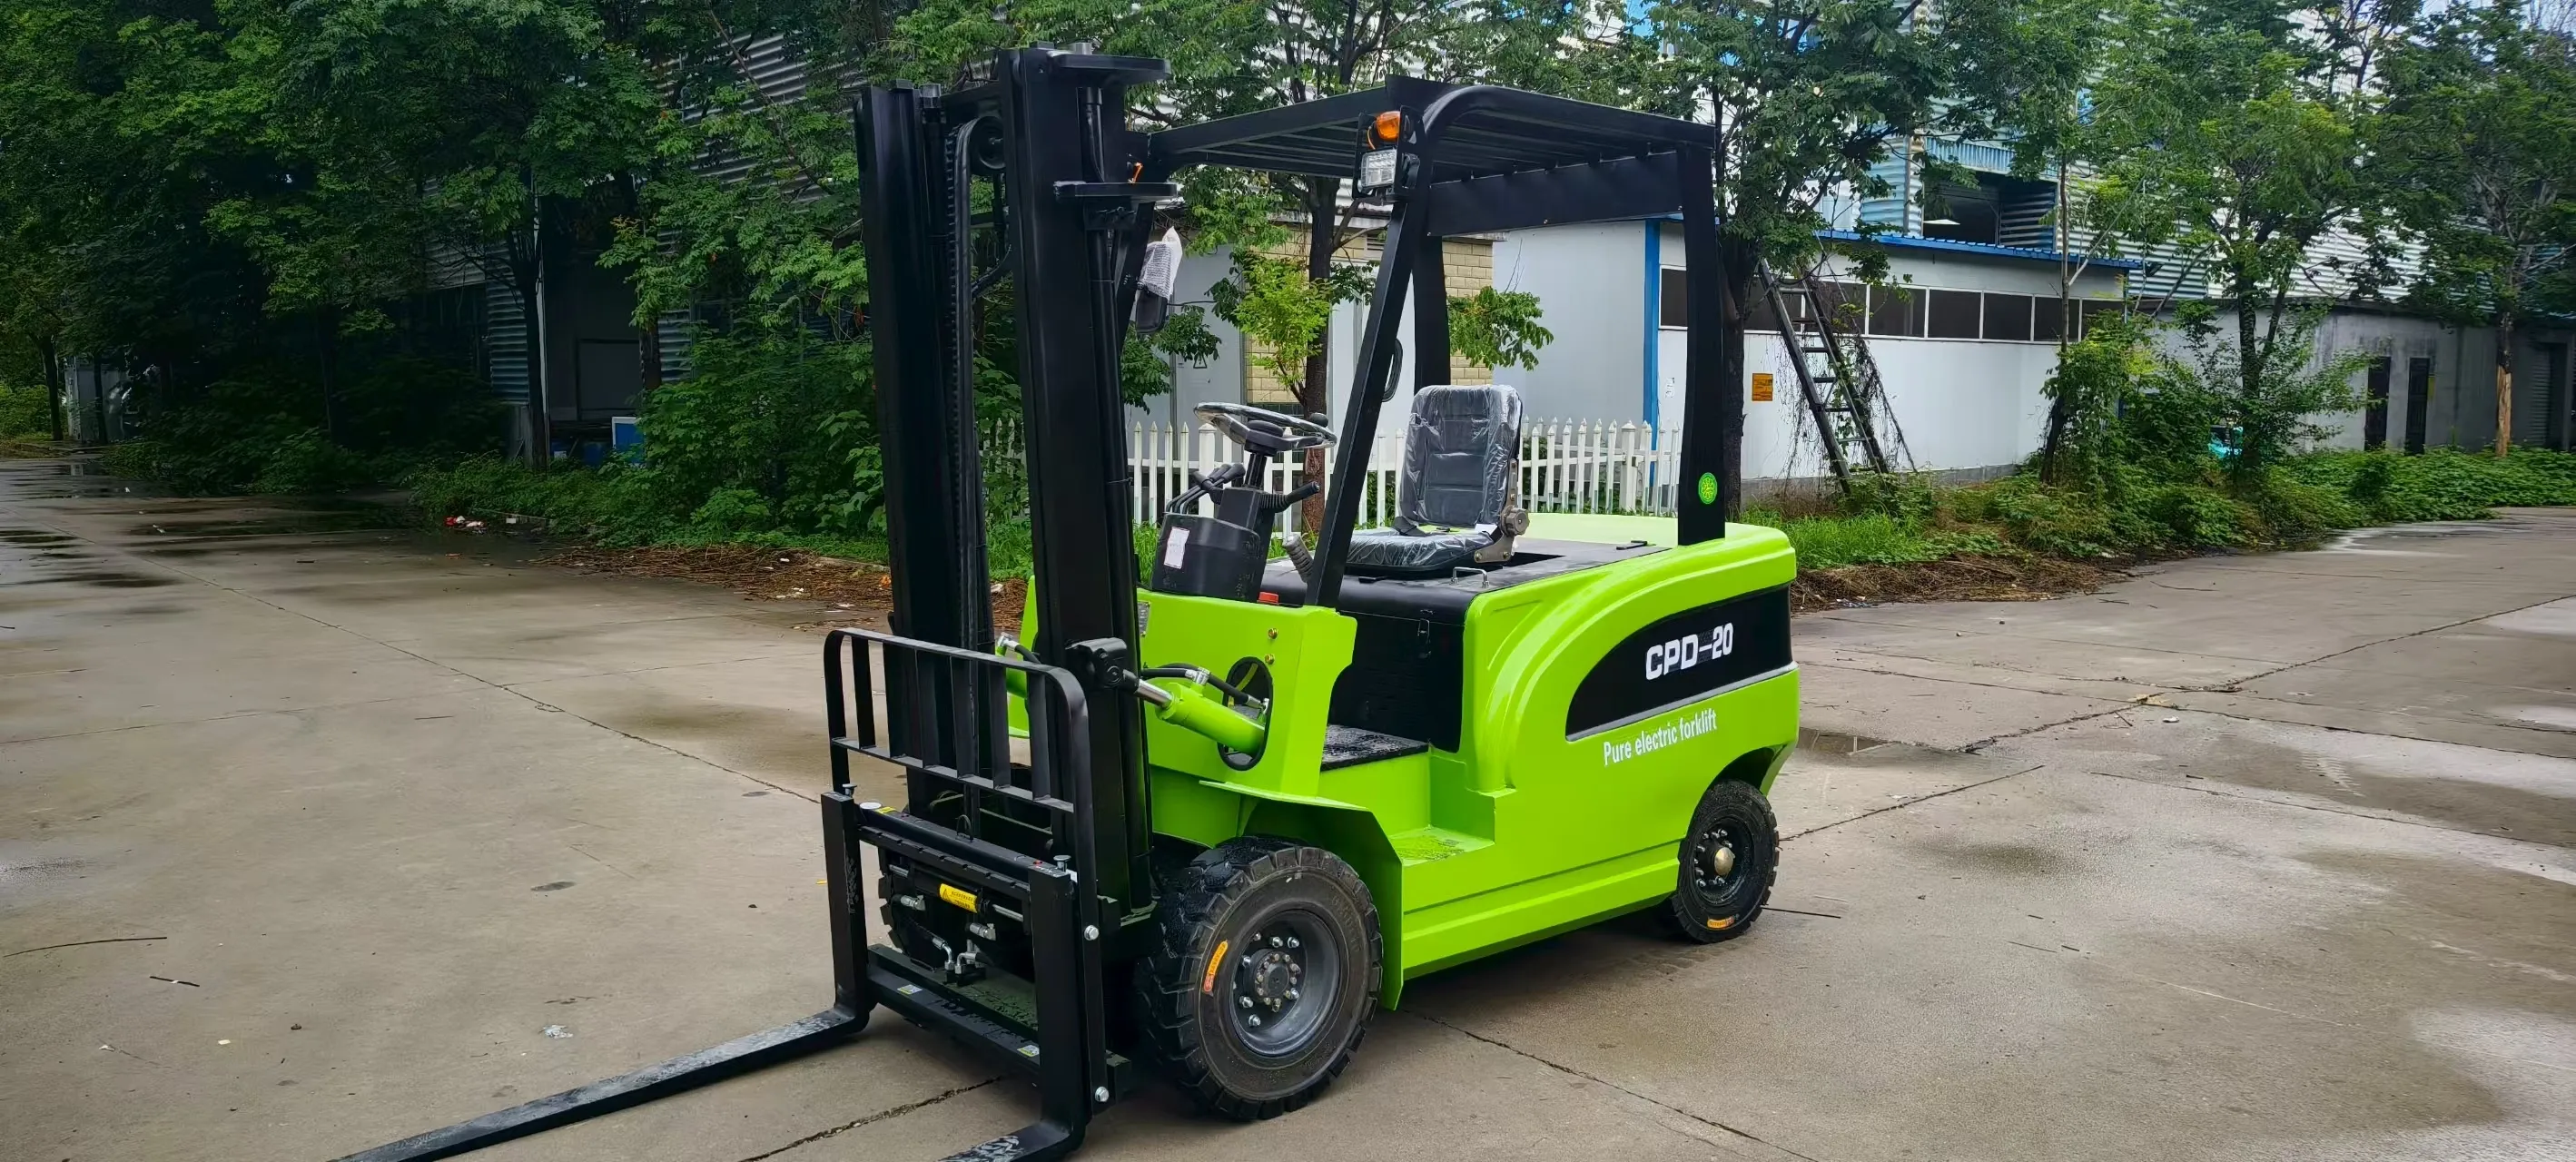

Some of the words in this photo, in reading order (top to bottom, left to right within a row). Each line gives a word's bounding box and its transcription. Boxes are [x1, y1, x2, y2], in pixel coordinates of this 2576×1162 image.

[1645, 622, 1733, 680] CPD-20
[1603, 741, 1632, 765] Pure
[1634, 724, 1678, 755] electric
[1679, 707, 1717, 740] forklift
